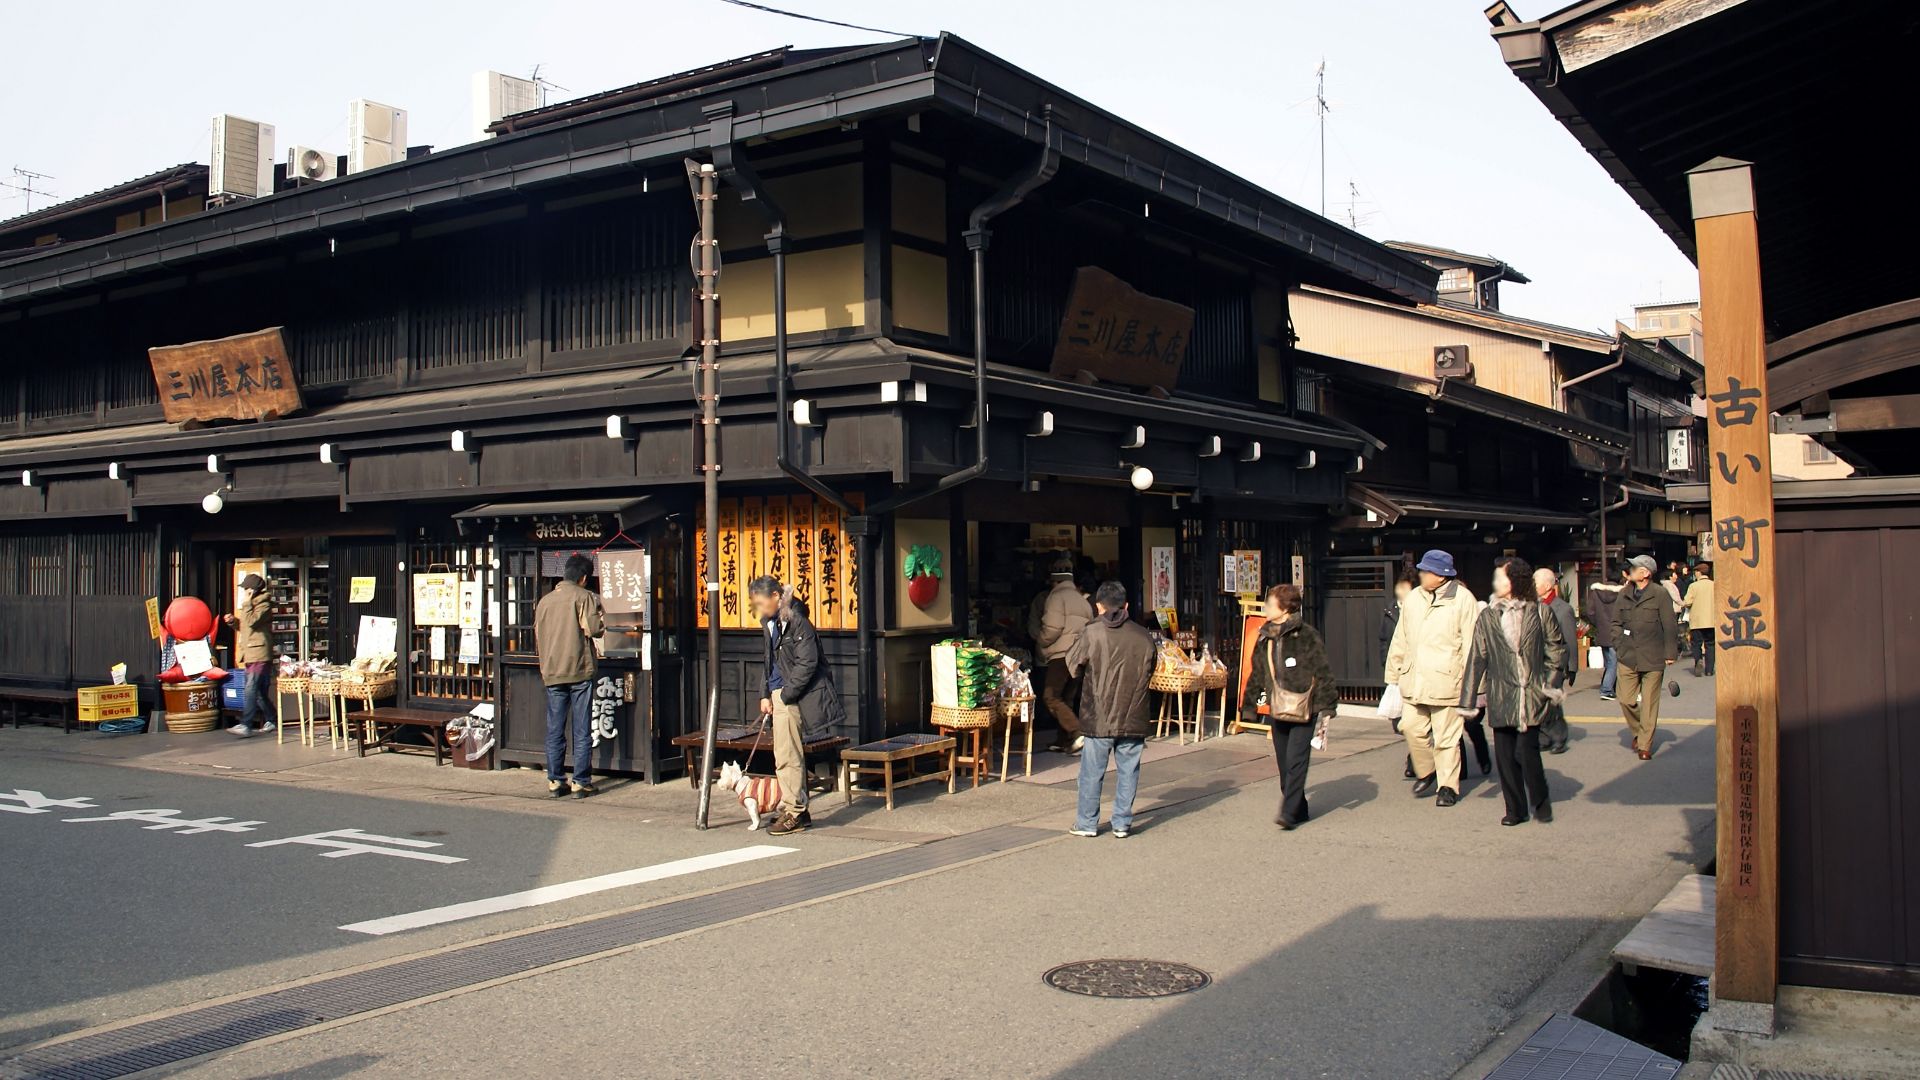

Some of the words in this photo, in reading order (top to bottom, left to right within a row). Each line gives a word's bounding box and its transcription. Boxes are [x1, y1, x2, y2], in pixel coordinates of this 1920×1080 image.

[168, 355, 283, 401] 三川屋本店
[1068, 310, 1183, 365] 三川屋本店
[1708, 376, 1772, 651] 古い町並
[722, 529, 738, 616] お漬物
[819, 527, 839, 615] 駄菓子
[1739, 718, 1753, 887] 重要伝統的建造物群保存地区
